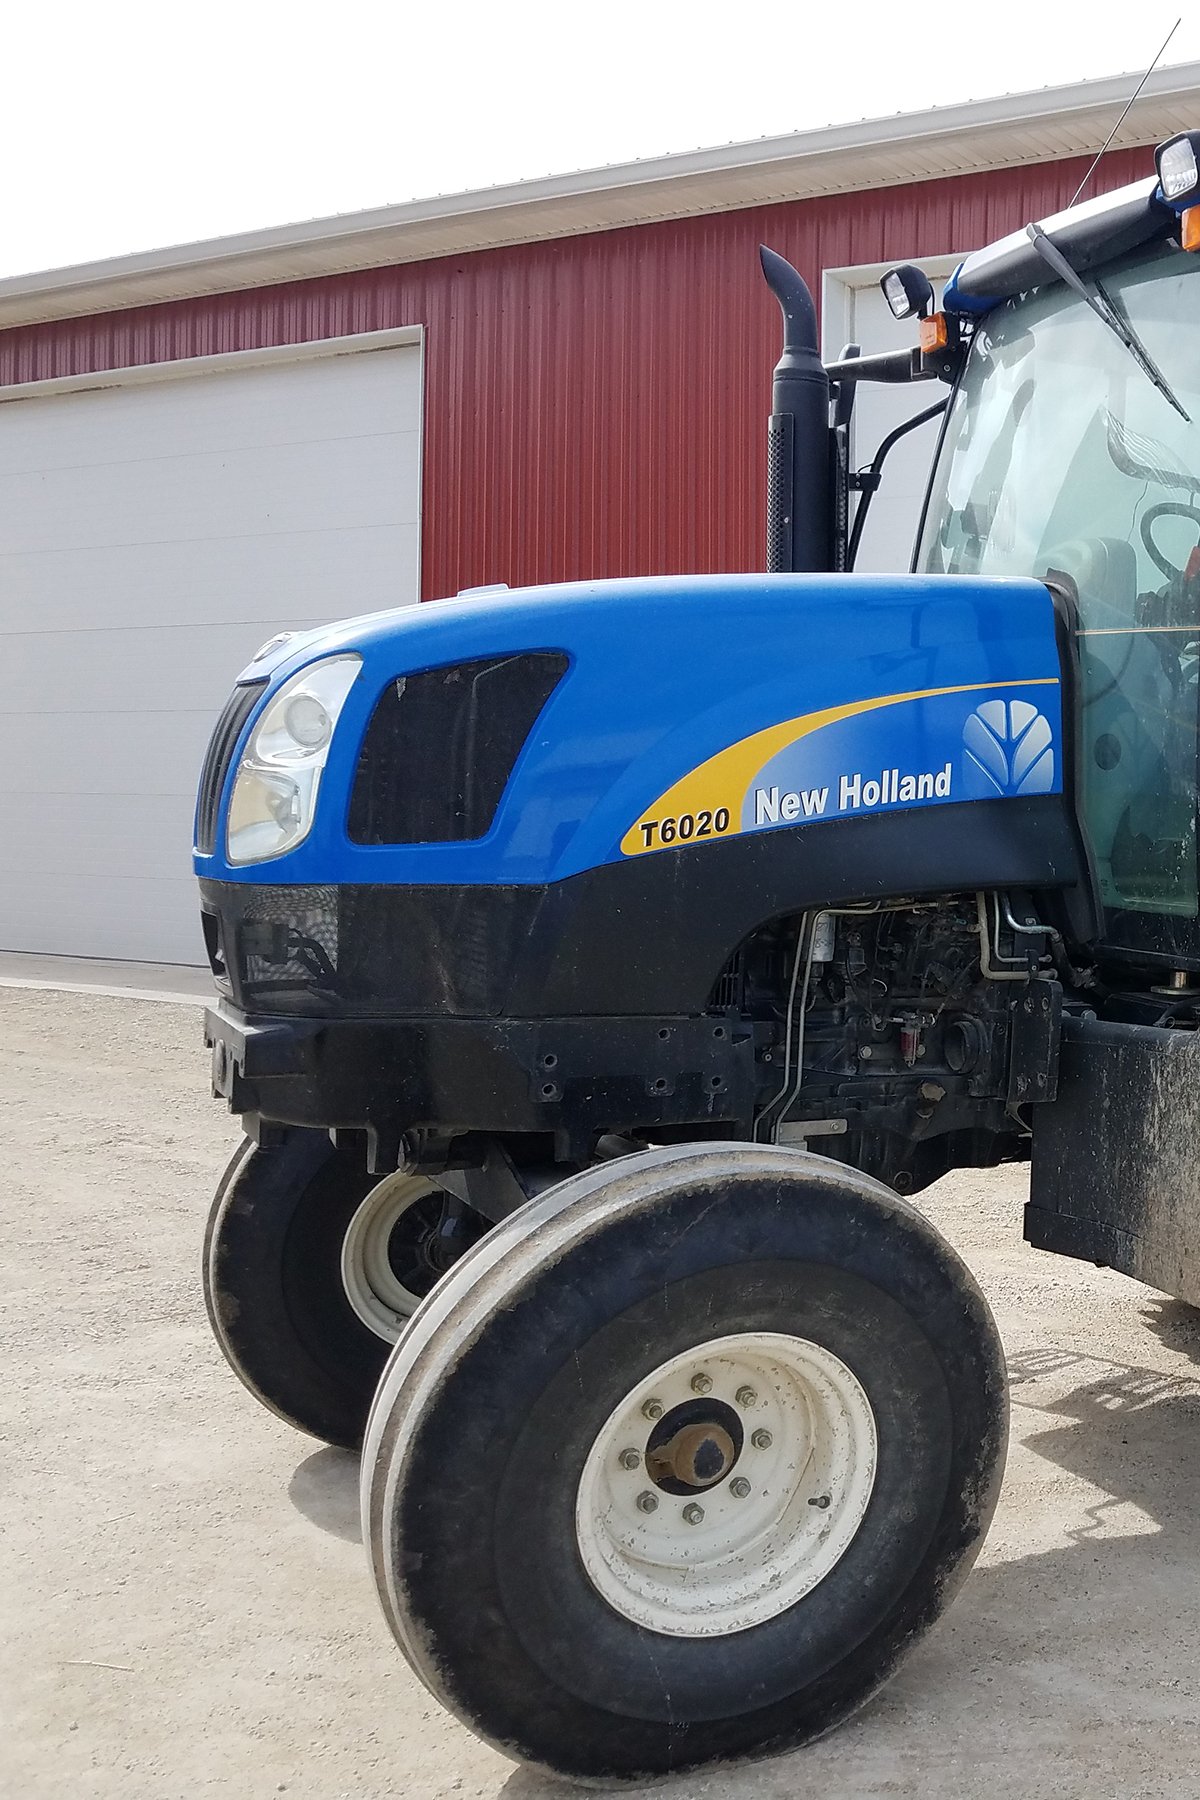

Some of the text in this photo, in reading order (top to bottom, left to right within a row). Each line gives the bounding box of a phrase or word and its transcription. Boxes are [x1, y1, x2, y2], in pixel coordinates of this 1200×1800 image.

[754, 763, 952, 825] New Holland
[639, 807, 730, 848] T6020
